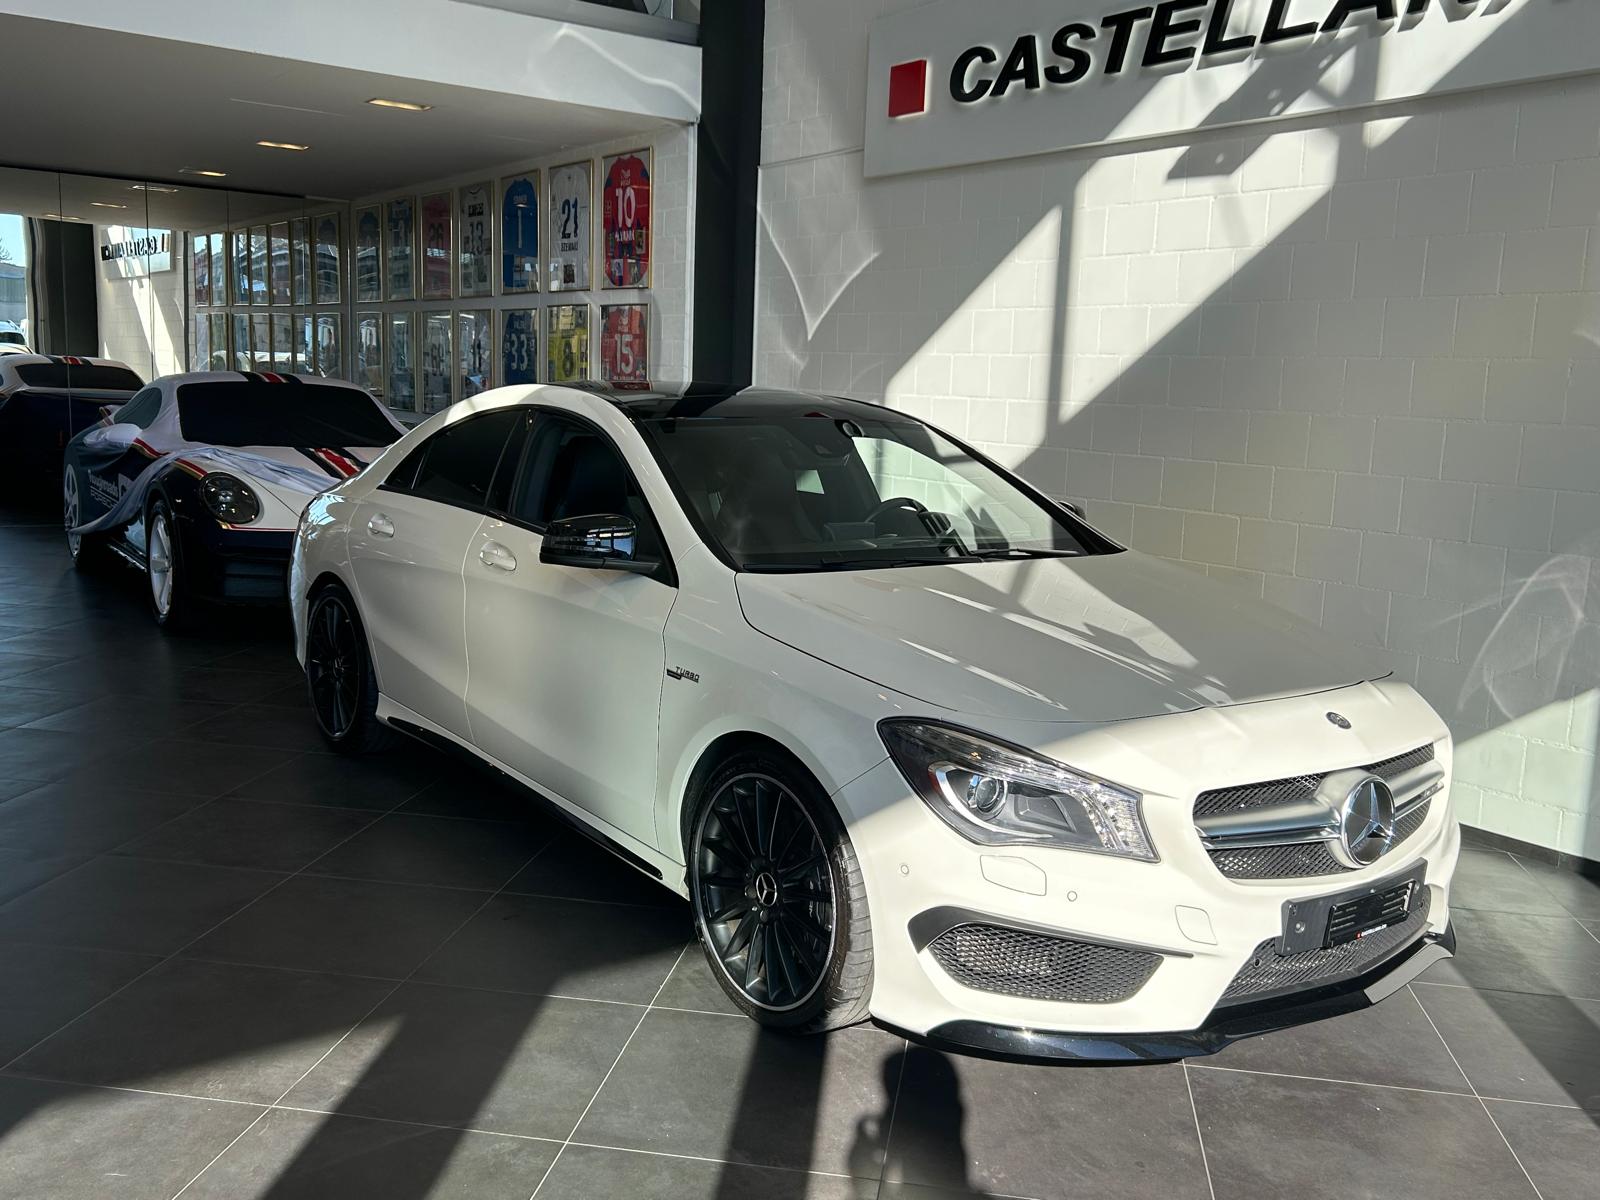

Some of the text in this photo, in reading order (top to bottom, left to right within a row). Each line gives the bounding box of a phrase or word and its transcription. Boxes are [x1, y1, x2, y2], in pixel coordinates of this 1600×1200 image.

[949, 0, 1482, 103] CASTELLA
[561, 196, 579, 239] 21
[615, 185, 636, 229] 10
[510, 332, 528, 372] 33
[614, 333, 634, 375] 15
[675, 665, 700, 682] TURBO
